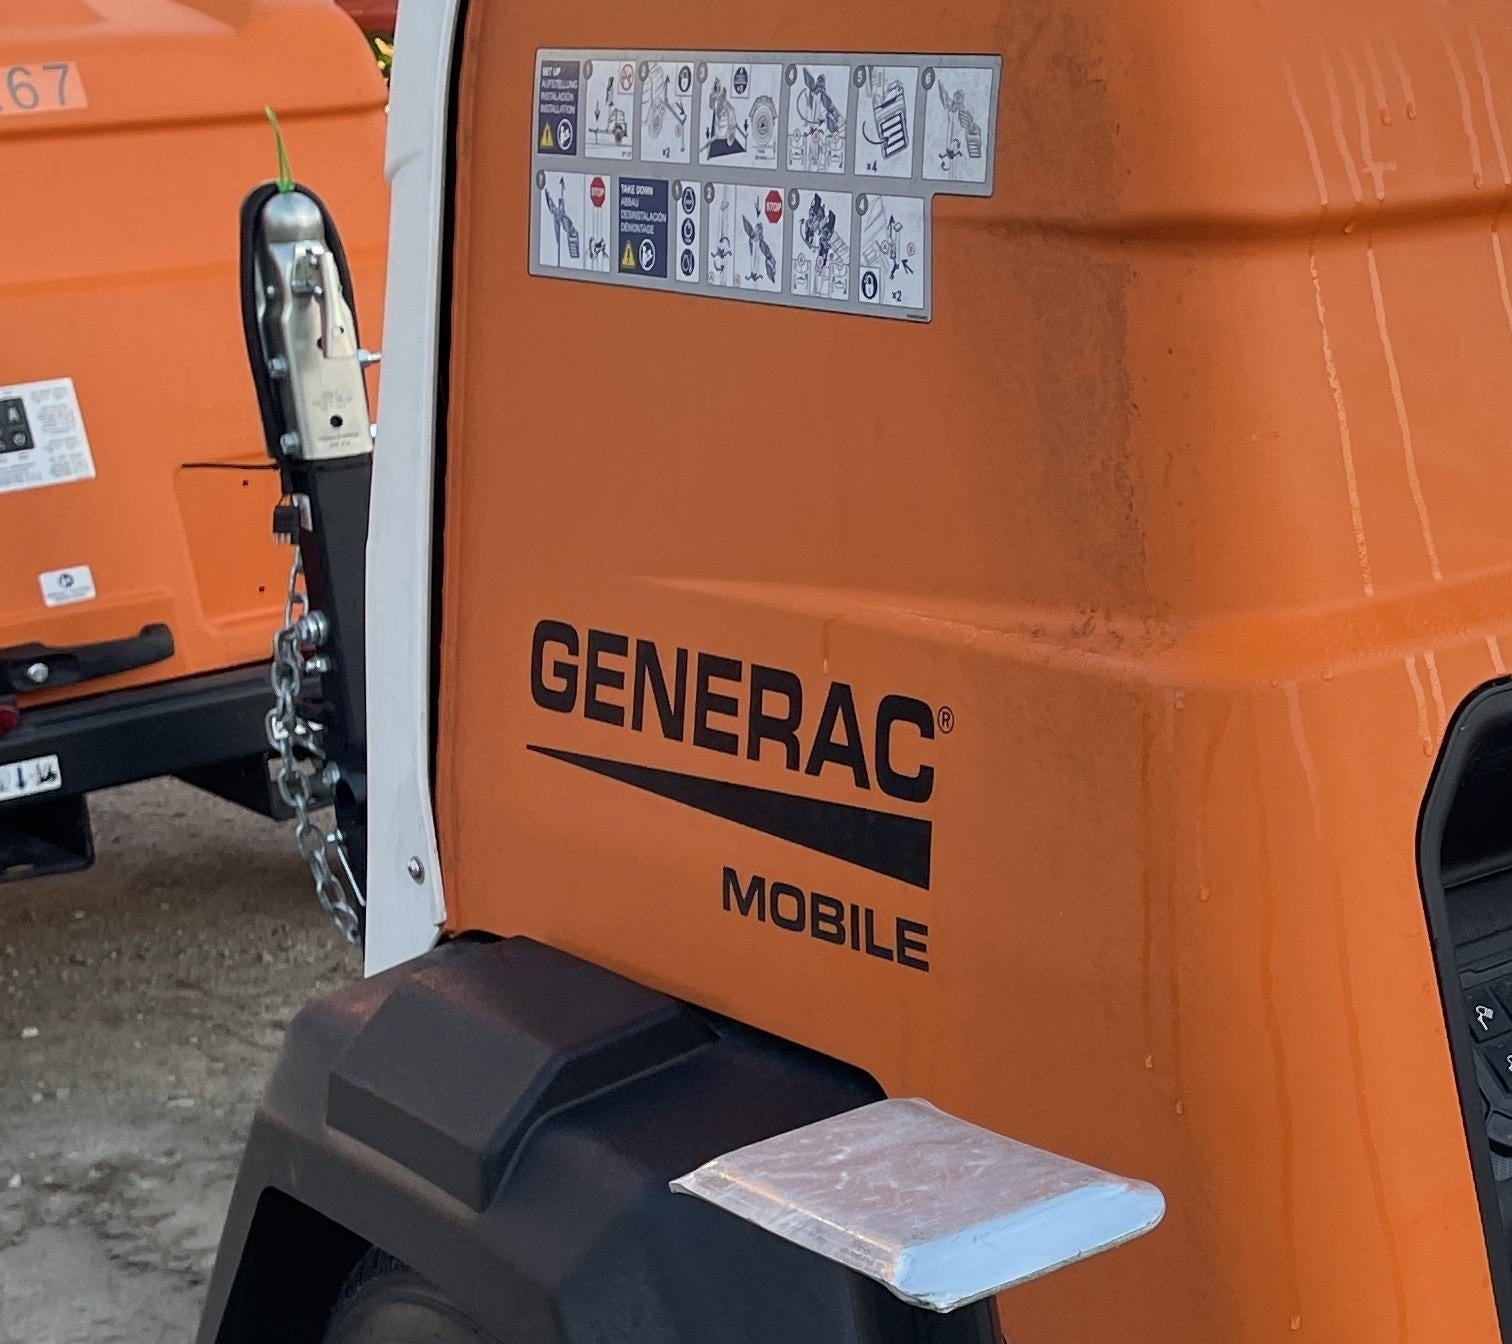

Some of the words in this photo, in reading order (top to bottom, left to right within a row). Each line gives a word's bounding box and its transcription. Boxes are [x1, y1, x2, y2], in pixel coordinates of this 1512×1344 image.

[553, 66, 561, 76] UP
[0, 64, 69, 111] 67
[620, 184, 635, 195] TAKE
[636, 186, 654, 196] DOWN
[766, 202, 782, 212] STOP
[530, 619, 935, 804] GENERAC
[722, 866, 930, 972] MOBILE
